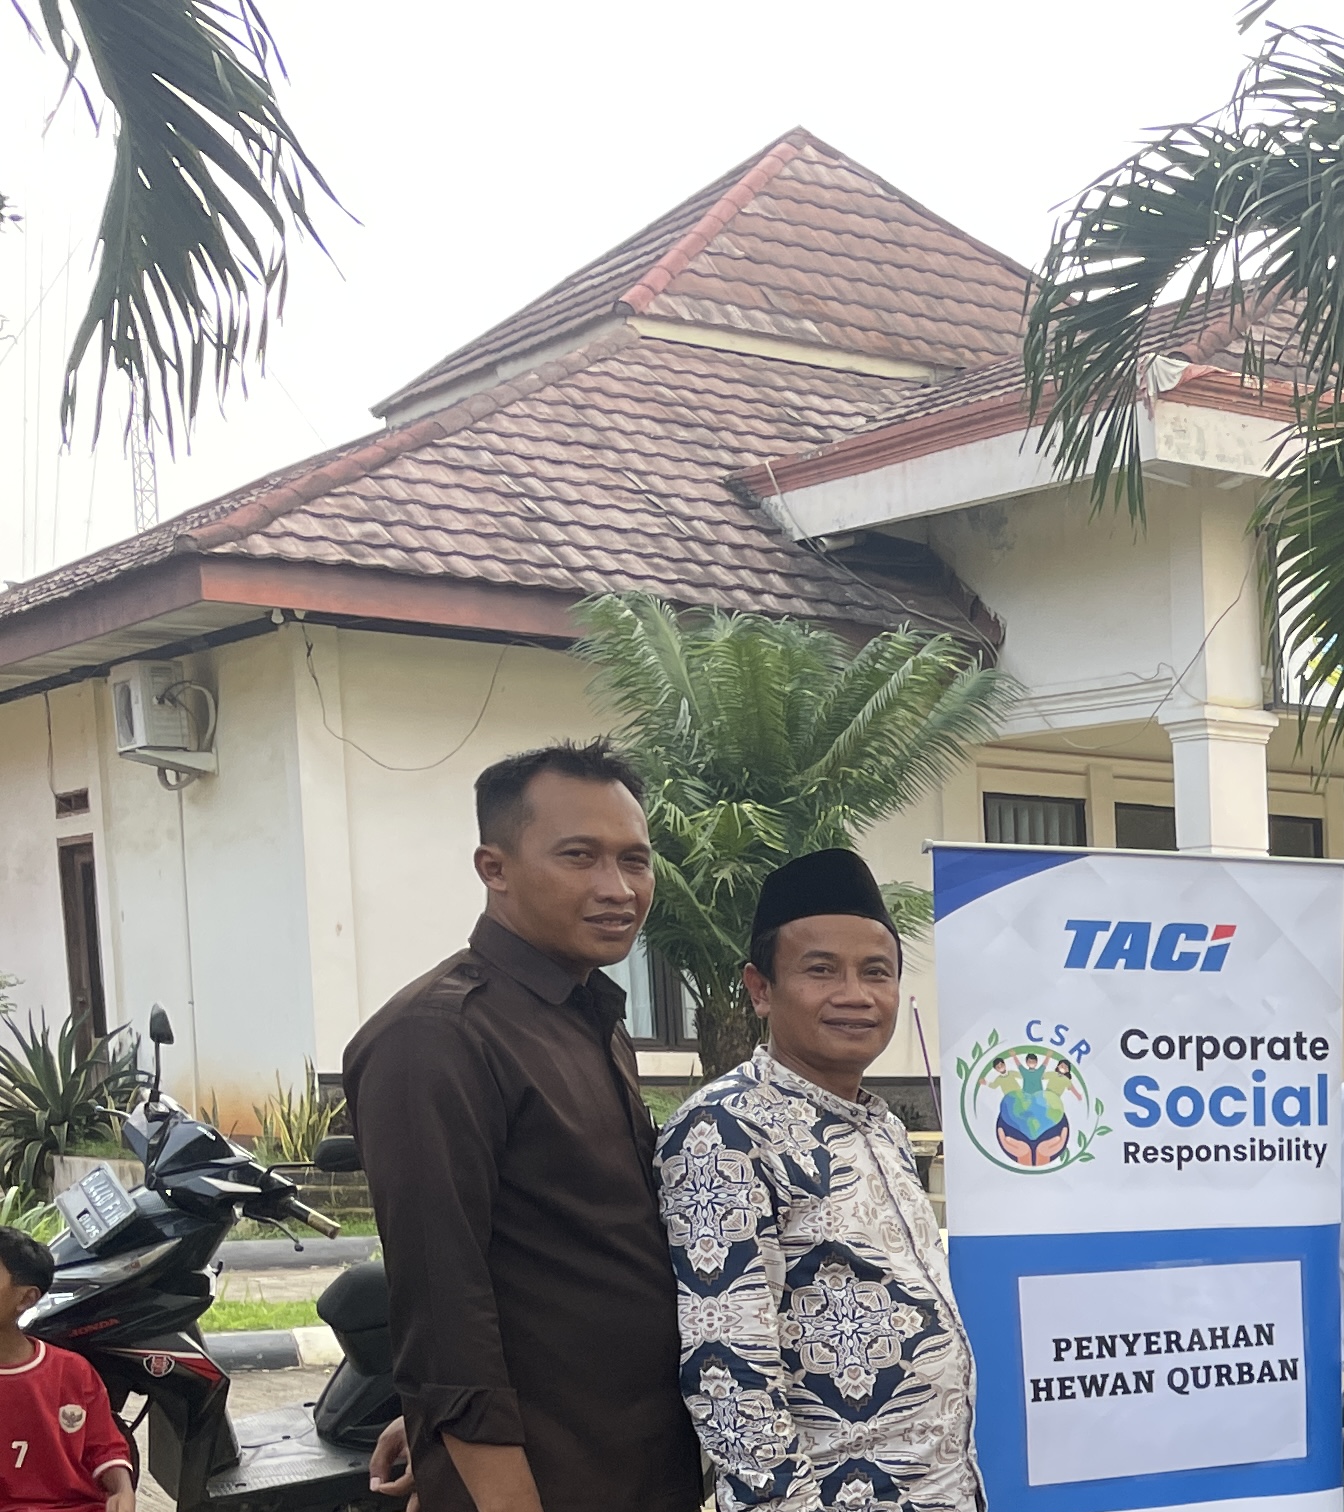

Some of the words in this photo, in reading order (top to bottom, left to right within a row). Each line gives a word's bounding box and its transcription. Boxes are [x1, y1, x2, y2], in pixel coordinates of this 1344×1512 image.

[1120, 1028, 1330, 1070] Corporate
[1123, 1069, 1329, 1128] Social
[1123, 1140, 1327, 1170] Responsibility
[1052, 1322, 1276, 1362] PENYERAHAN
[1030, 1370, 1155, 1403] HEWAN
[1167, 1357, 1299, 1395] QURBAN
[11, 1441, 28, 1468] 7
